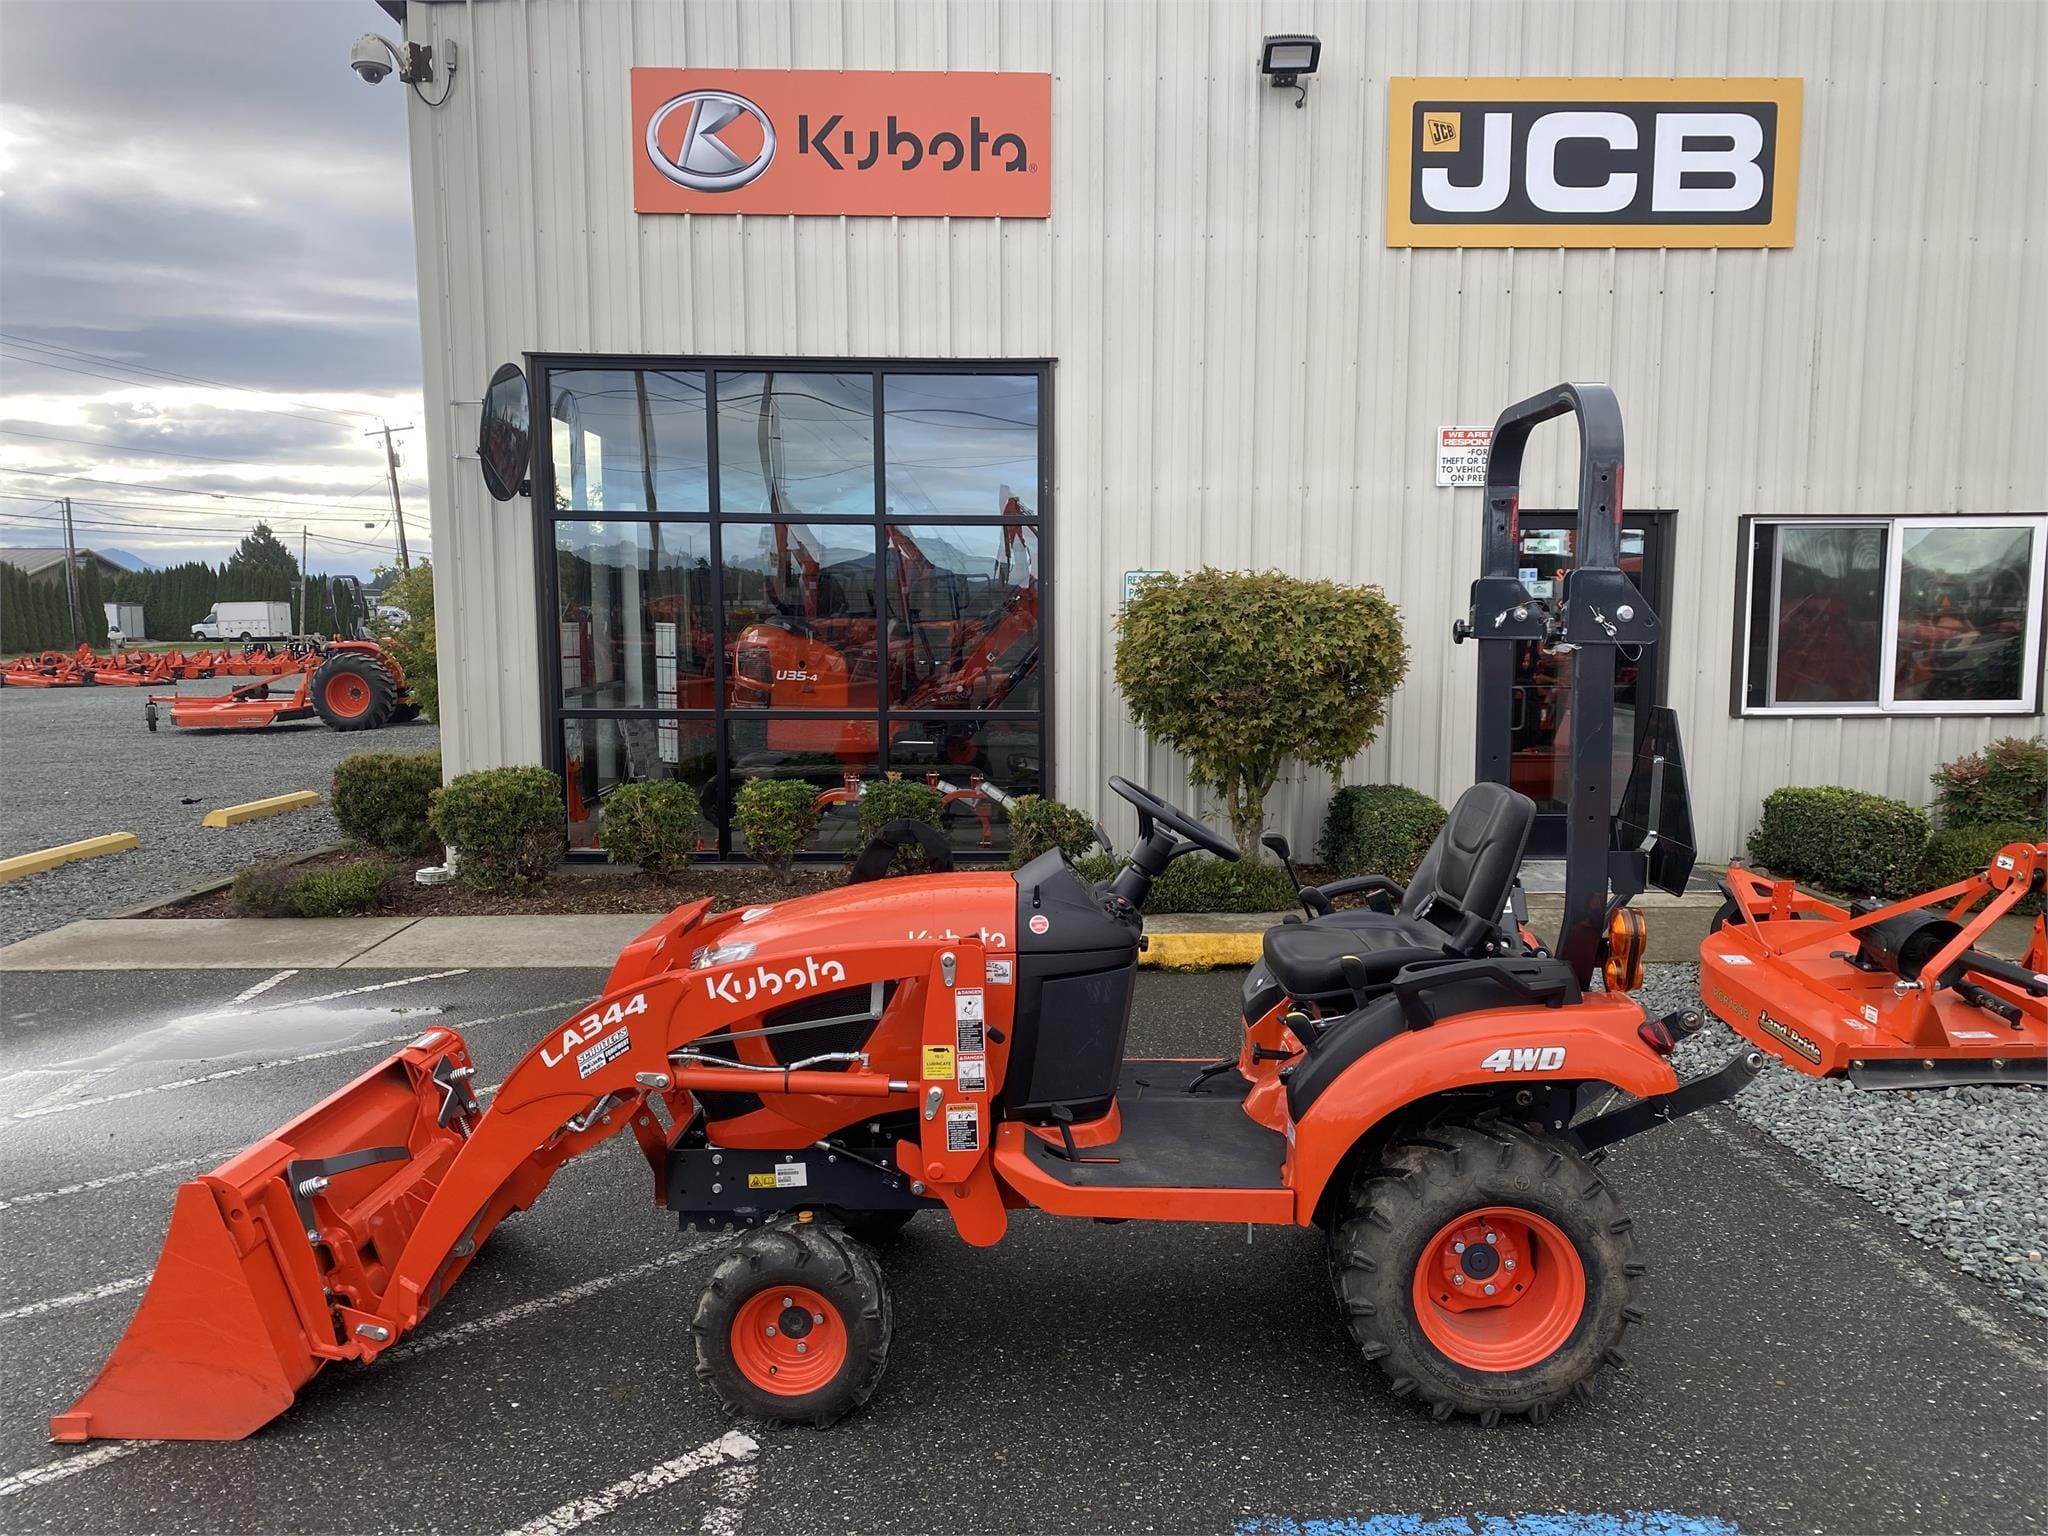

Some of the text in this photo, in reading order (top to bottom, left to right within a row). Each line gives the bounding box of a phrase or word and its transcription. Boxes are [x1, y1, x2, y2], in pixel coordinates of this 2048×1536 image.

[798, 114, 1028, 172] Kubota
[1433, 122, 1455, 142] JCB
[1421, 111, 1765, 213] JCB
[1441, 457, 1465, 465] THEFT
[1466, 457, 1479, 465] OR
[1441, 465, 1454, 473] TO
[1450, 474, 1464, 482] ON
[776, 670, 818, 681] U35-4
[705, 956, 846, 1004] Kubota
[539, 993, 648, 1068] LA344
[1480, 1046, 1567, 1073] 4WD
